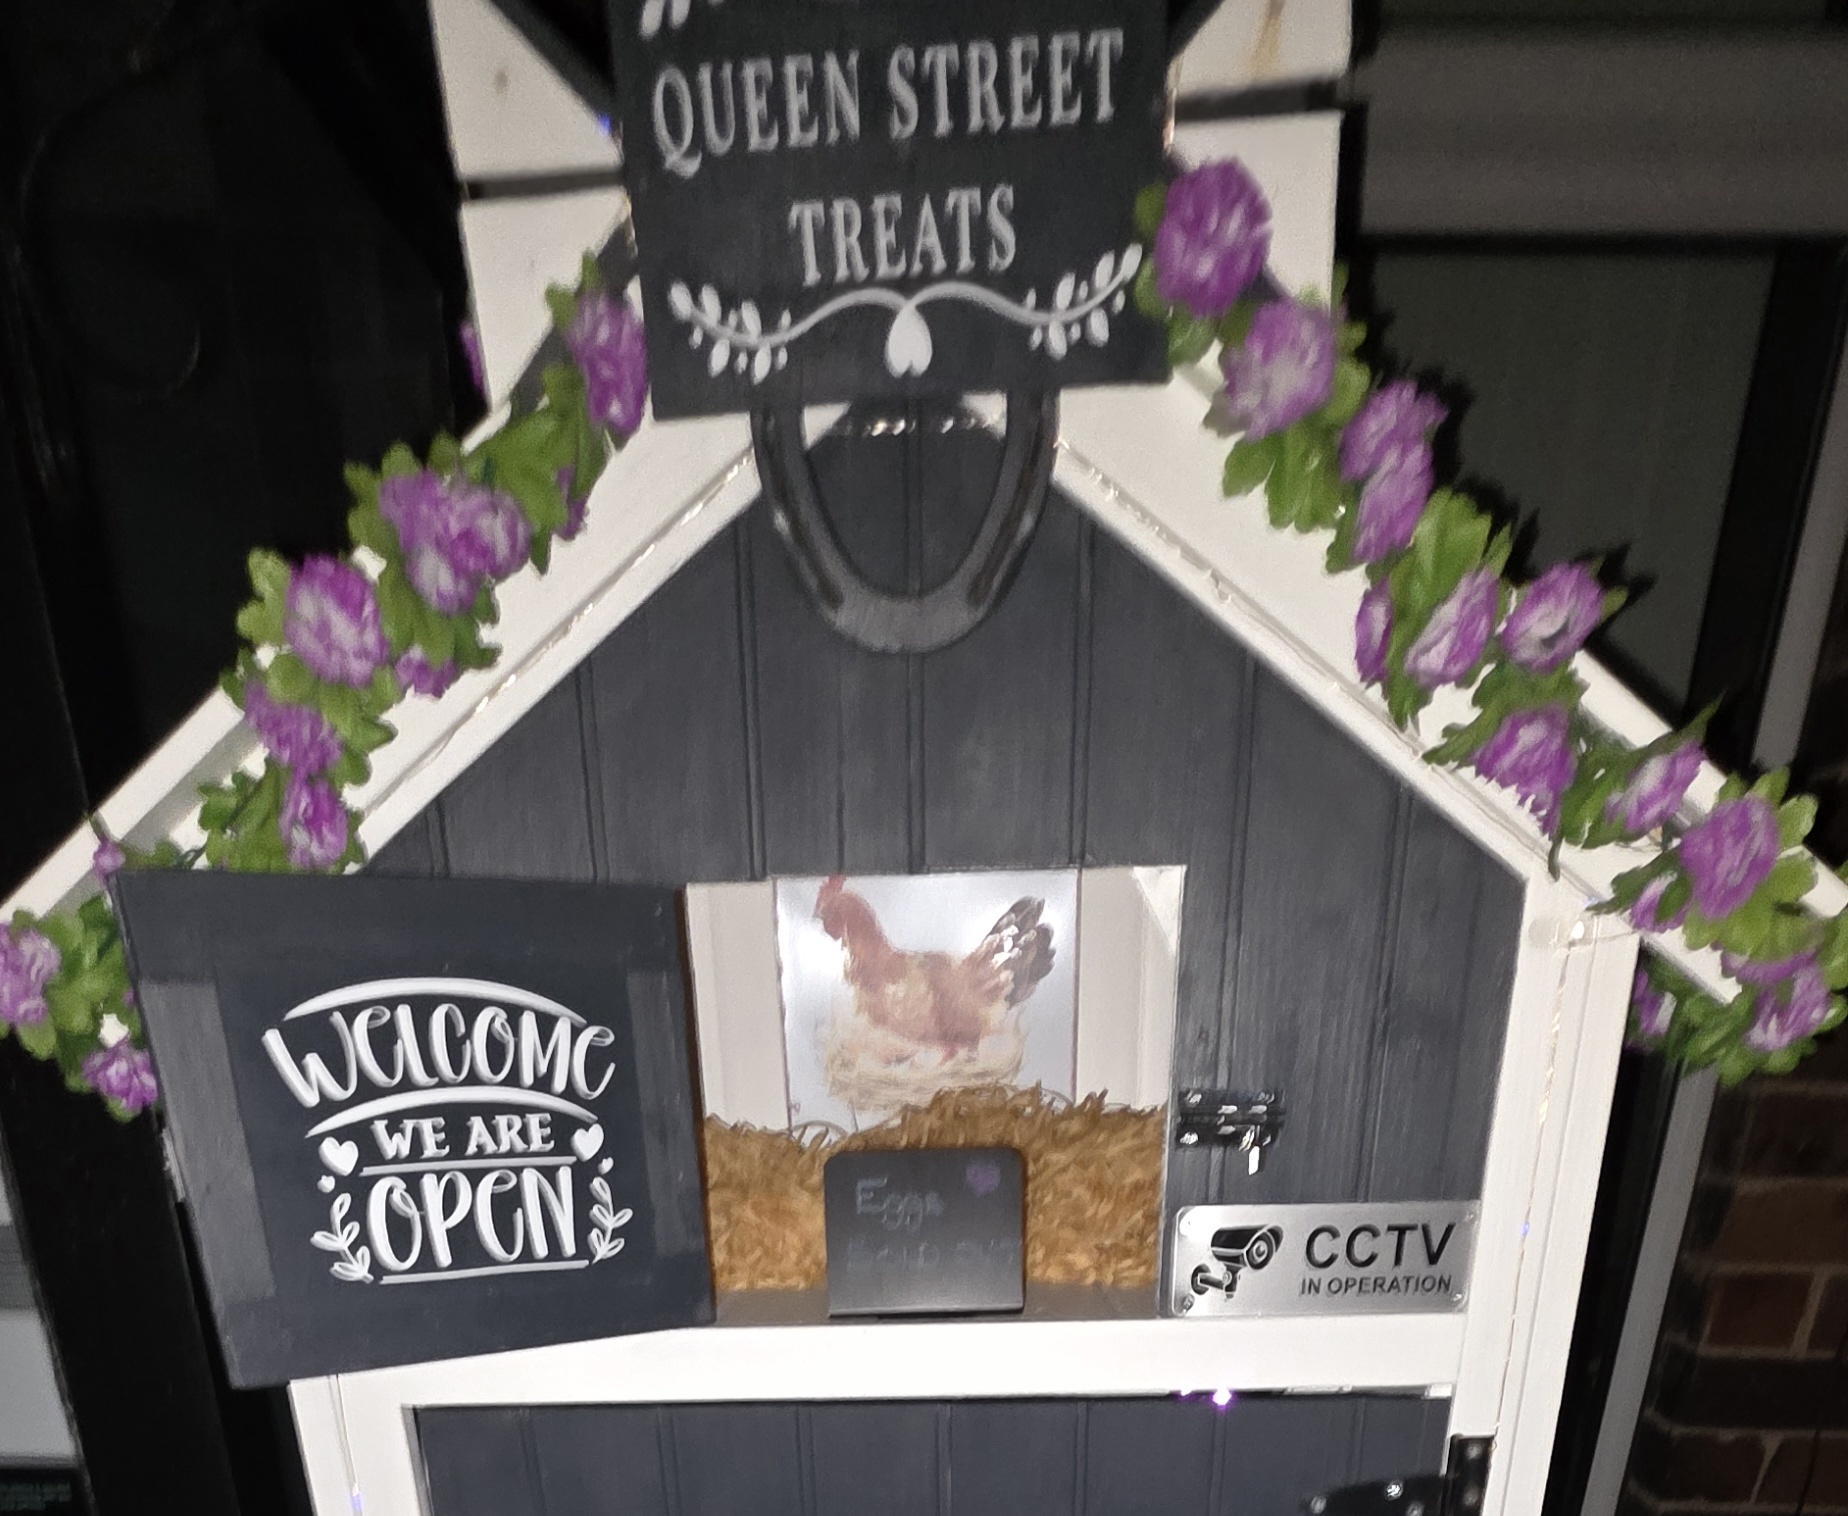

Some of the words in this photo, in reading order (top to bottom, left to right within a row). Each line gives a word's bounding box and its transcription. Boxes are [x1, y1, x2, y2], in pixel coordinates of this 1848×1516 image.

[652, 50, 861, 180] QUEEN
[887, 27, 1124, 141] STREET
[788, 182, 1017, 287] TREATS
[370, 1116, 450, 1160] WE
[464, 1112, 555, 1157] ARE
[1304, 1221, 1457, 1270] CCTV
[1301, 1277, 1322, 1296] IN
[1327, 1273, 1454, 1296] OPERATION
